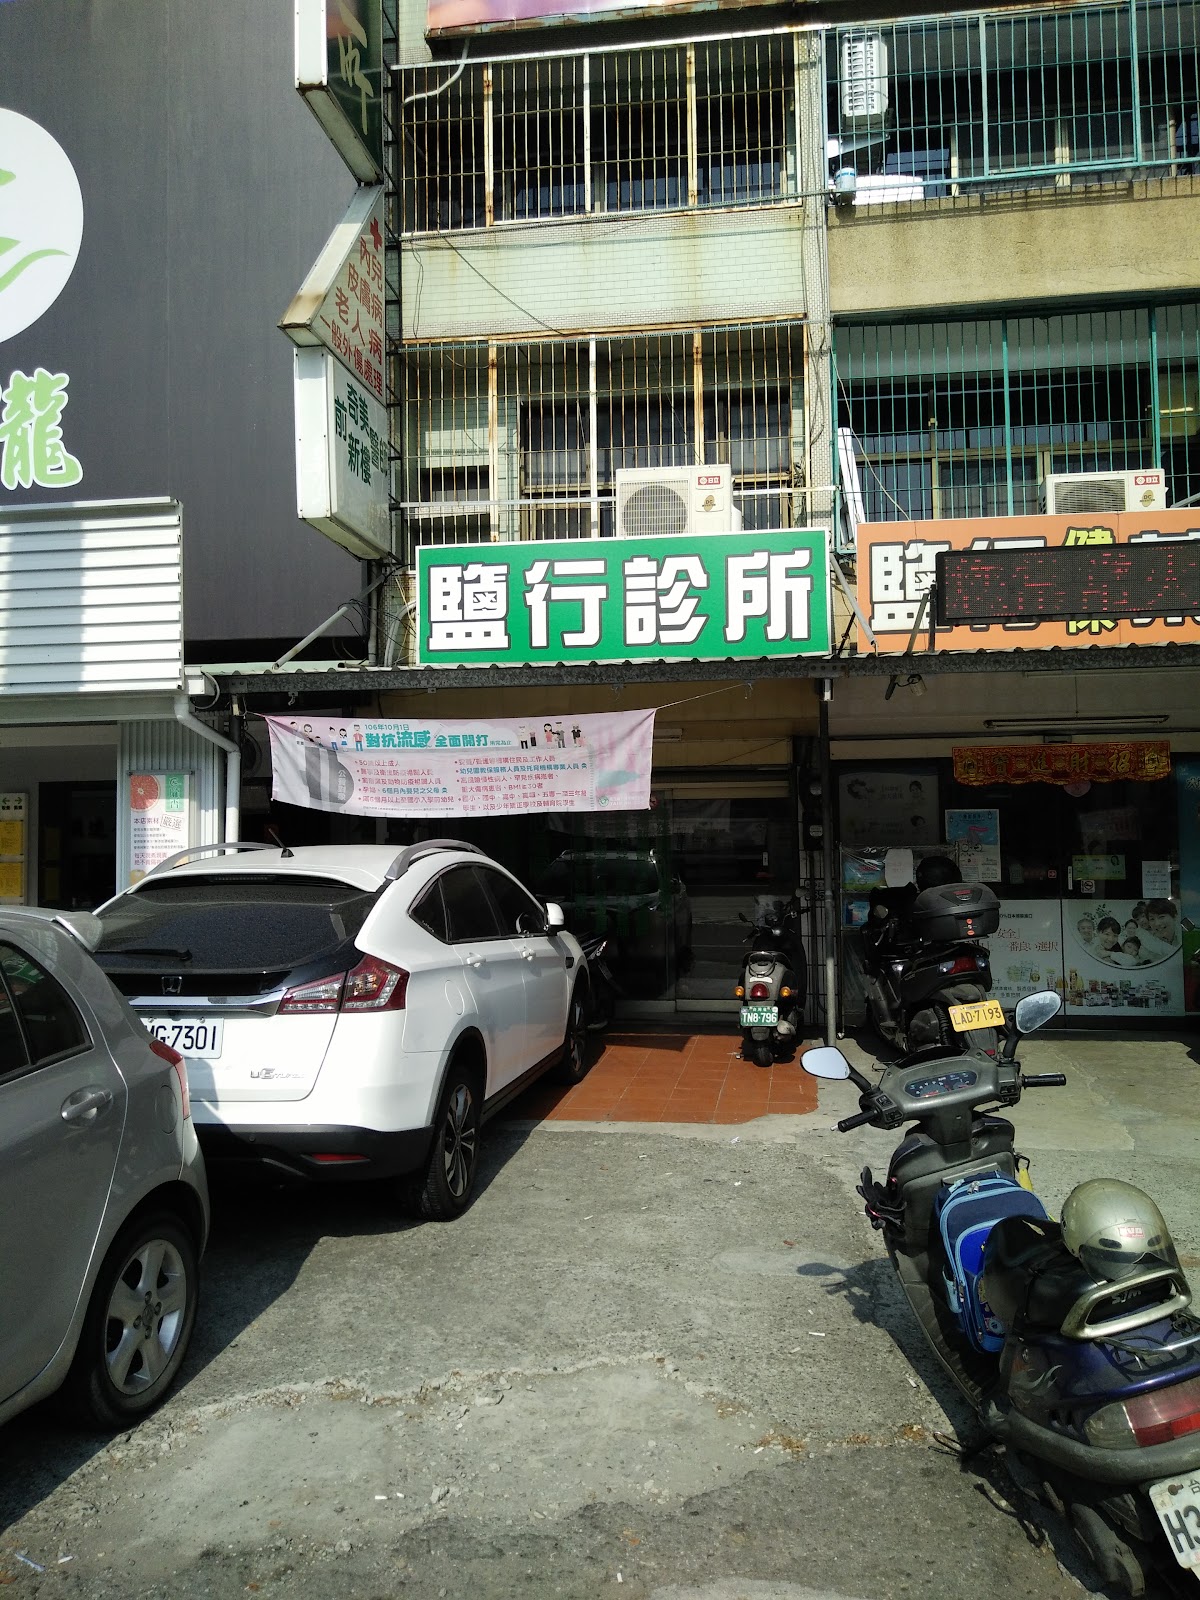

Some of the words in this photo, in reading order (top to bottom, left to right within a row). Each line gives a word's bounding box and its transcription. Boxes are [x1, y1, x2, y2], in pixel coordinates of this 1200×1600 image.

[348, 262, 383, 328] 皮膚病
[335, 286, 382, 366] 老人病
[320, 314, 383, 397] 一般外傷處理
[334, 395, 347, 442] 前
[427, 548, 814, 651] 鹽行診所
[365, 730, 432, 748] 對抗流感
[434, 734, 489, 748] 全面開打
[742, 1012, 777, 1023] TN8-796
[952, 1007, 1002, 1025] LAD-7193
